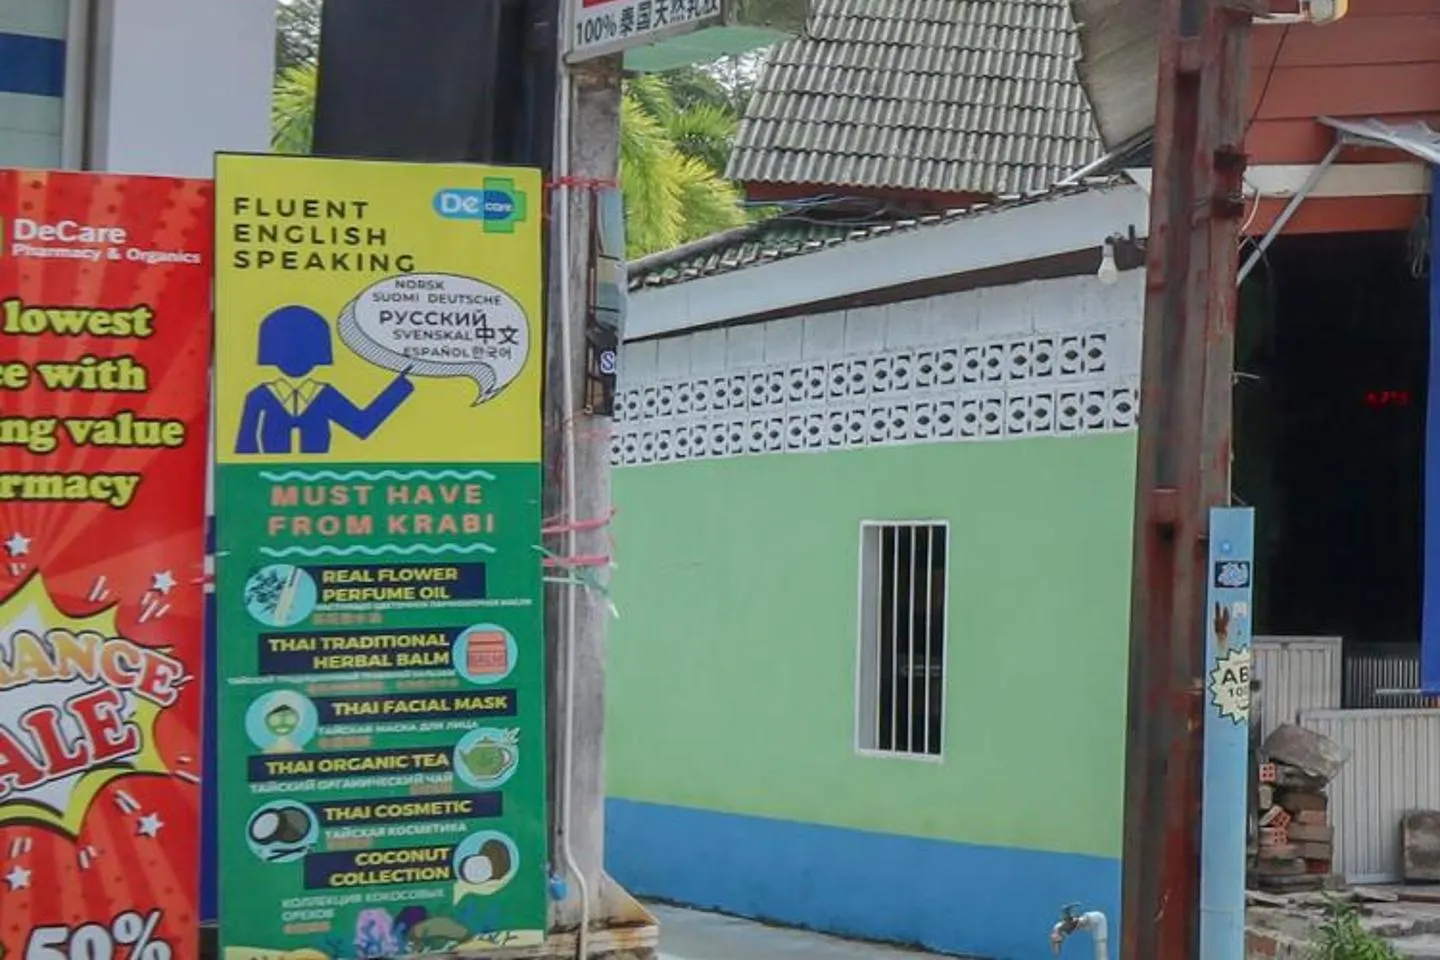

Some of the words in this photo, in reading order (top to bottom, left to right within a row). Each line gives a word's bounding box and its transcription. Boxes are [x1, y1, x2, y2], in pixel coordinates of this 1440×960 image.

[233, 197, 370, 220] FLUENT
[441, 192, 480, 213] De
[14, 218, 127, 244] DeCare
[233, 224, 388, 247] ENGLISH
[12, 243, 101, 262] Pharmacy
[107, 247, 121, 261] &
[126, 247, 201, 264] Organics
[233, 250, 416, 273] SPEAKING
[394, 279, 445, 290] NORSK
[372, 292, 420, 302] SUOMI
[428, 293, 501, 306] DEUTSCHE
[2, 300, 154, 338] lowest
[379, 309, 487, 327] РУССКИЙ
[475, 325, 519, 345] 中文
[403, 344, 472, 358] ESPAÑOL
[36, 356, 148, 390] with
[64, 412, 185, 446] value
[271, 484, 375, 506] MUST
[388, 484, 483, 505] HAVE
[267, 515, 374, 537] FROM
[388, 512, 496, 535] KRABI
[322, 568, 374, 583] REAL
[377, 566, 458, 582] FLOWER
[322, 587, 416, 602] PERFUME
[420, 586, 450, 600] OIL
[268, 638, 316, 652] THAI
[321, 634, 451, 651] TRADITIONAL
[313, 654, 393, 670] HERBAL
[398, 652, 450, 667] BALM
[331, 701, 381, 716] THAI
[383, 698, 452, 715] FACIAL
[454, 696, 508, 712] MASK
[265, 760, 316, 776] THAI
[317, 757, 409, 773] ORGANIC
[411, 754, 450, 769] TEA
[323, 805, 371, 821] THAI
[374, 800, 473, 817] COSMETIC
[355, 847, 450, 866] COCONUT
[329, 867, 450, 887] COLLECTION
